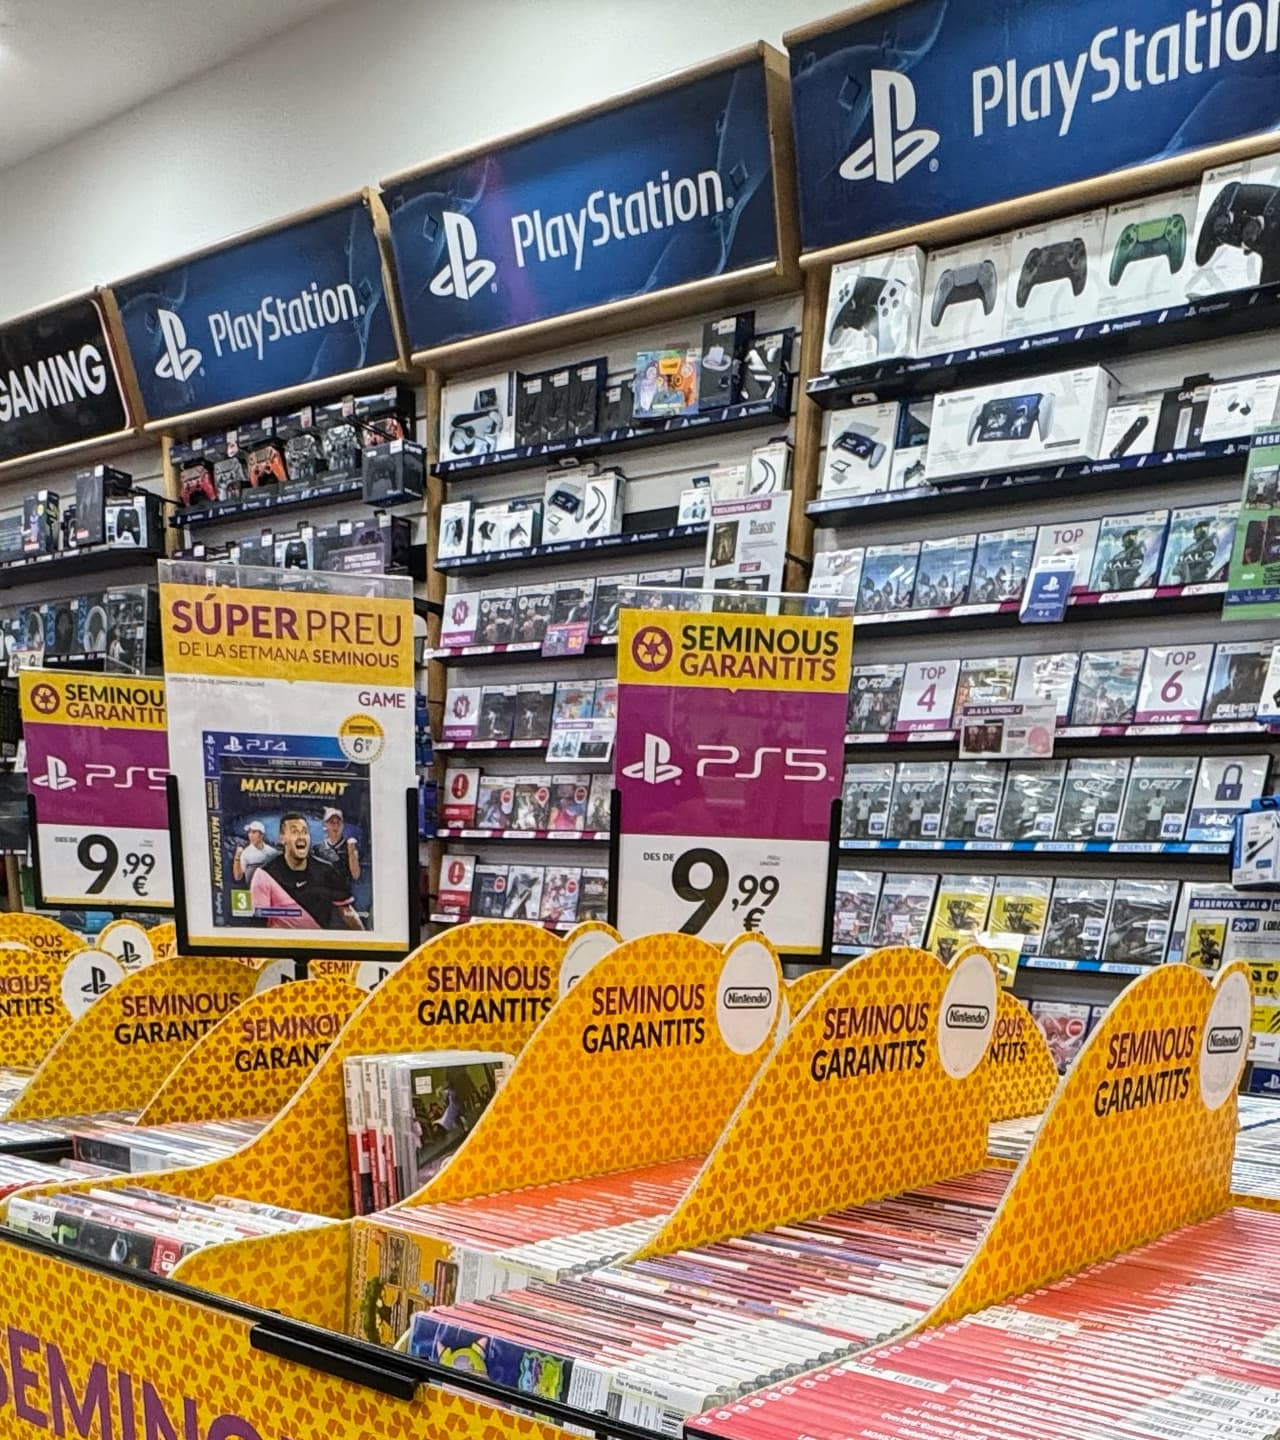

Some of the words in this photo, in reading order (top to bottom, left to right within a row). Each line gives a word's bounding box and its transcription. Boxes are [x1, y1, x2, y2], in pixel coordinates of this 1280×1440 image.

[510, 171, 734, 271] PlayStation
[209, 280, 365, 360] PlayStation
[1053, 528, 1084, 545] TOP
[171, 593, 300, 640] SÚPER
[306, 609, 402, 647] PREU
[179, 641, 204, 657] DE
[206, 643, 226, 659] LA
[228, 643, 309, 663] SETMANA
[312, 648, 400, 669] SEMINOUS
[680, 624, 839, 657] SEMINOUS
[679, 650, 836, 682] GARANTITS
[919, 666, 946, 681] TOP
[1165, 651, 1196, 667] TOP
[65, 683, 165, 707] SEMINOU
[358, 691, 406, 709] GAME
[917, 683, 936, 713] 4
[1160, 670, 1184, 703] 6
[66, 703, 166, 724] GARANTIT
[246, 739, 289, 752] PS4
[695, 743, 830, 783] PS5
[240, 778, 349, 796] MATCHPOINT
[76, 833, 156, 896] 9,99
[671, 847, 780, 937] 9,99
[427, 965, 551, 994] SEMINOUS
[122, 991, 241, 1019] SEMINOUS
[418, 996, 553, 1027] GARANTITS
[592, 983, 706, 1016] SEMINOUS
[727, 991, 769, 1006] Nintendo
[822, 1003, 930, 1040] SEMINOUS
[949, 1008, 987, 1025] Nintendo
[582, 1018, 706, 1054] GARANTITS
[1106, 1027, 1197, 1070] SEMINOUS
[1209, 1030, 1241, 1049] Nintendo
[811, 1038, 926, 1083] GARANTITS
[1093, 1066, 1191, 1118] GARANTITS
